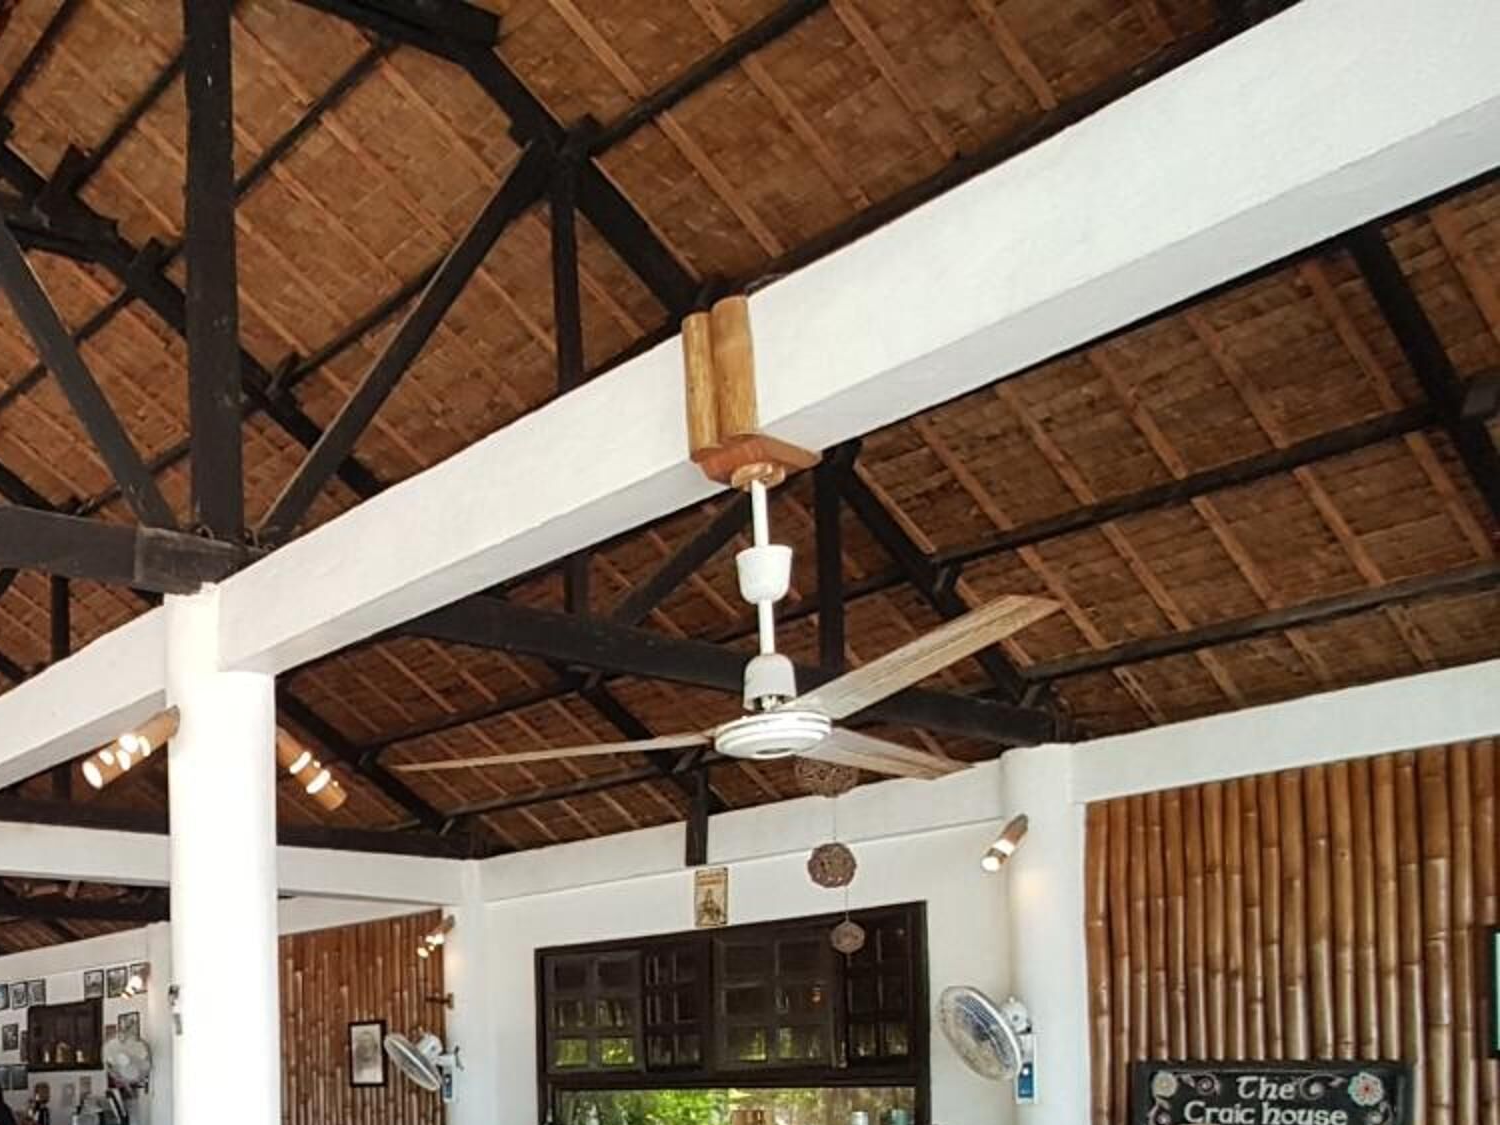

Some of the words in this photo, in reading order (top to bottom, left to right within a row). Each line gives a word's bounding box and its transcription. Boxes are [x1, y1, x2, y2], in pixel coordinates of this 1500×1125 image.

[1236, 1076, 1296, 1100] The
[1184, 1101, 1255, 1124] Craic
[1262, 1101, 1348, 1125] house
